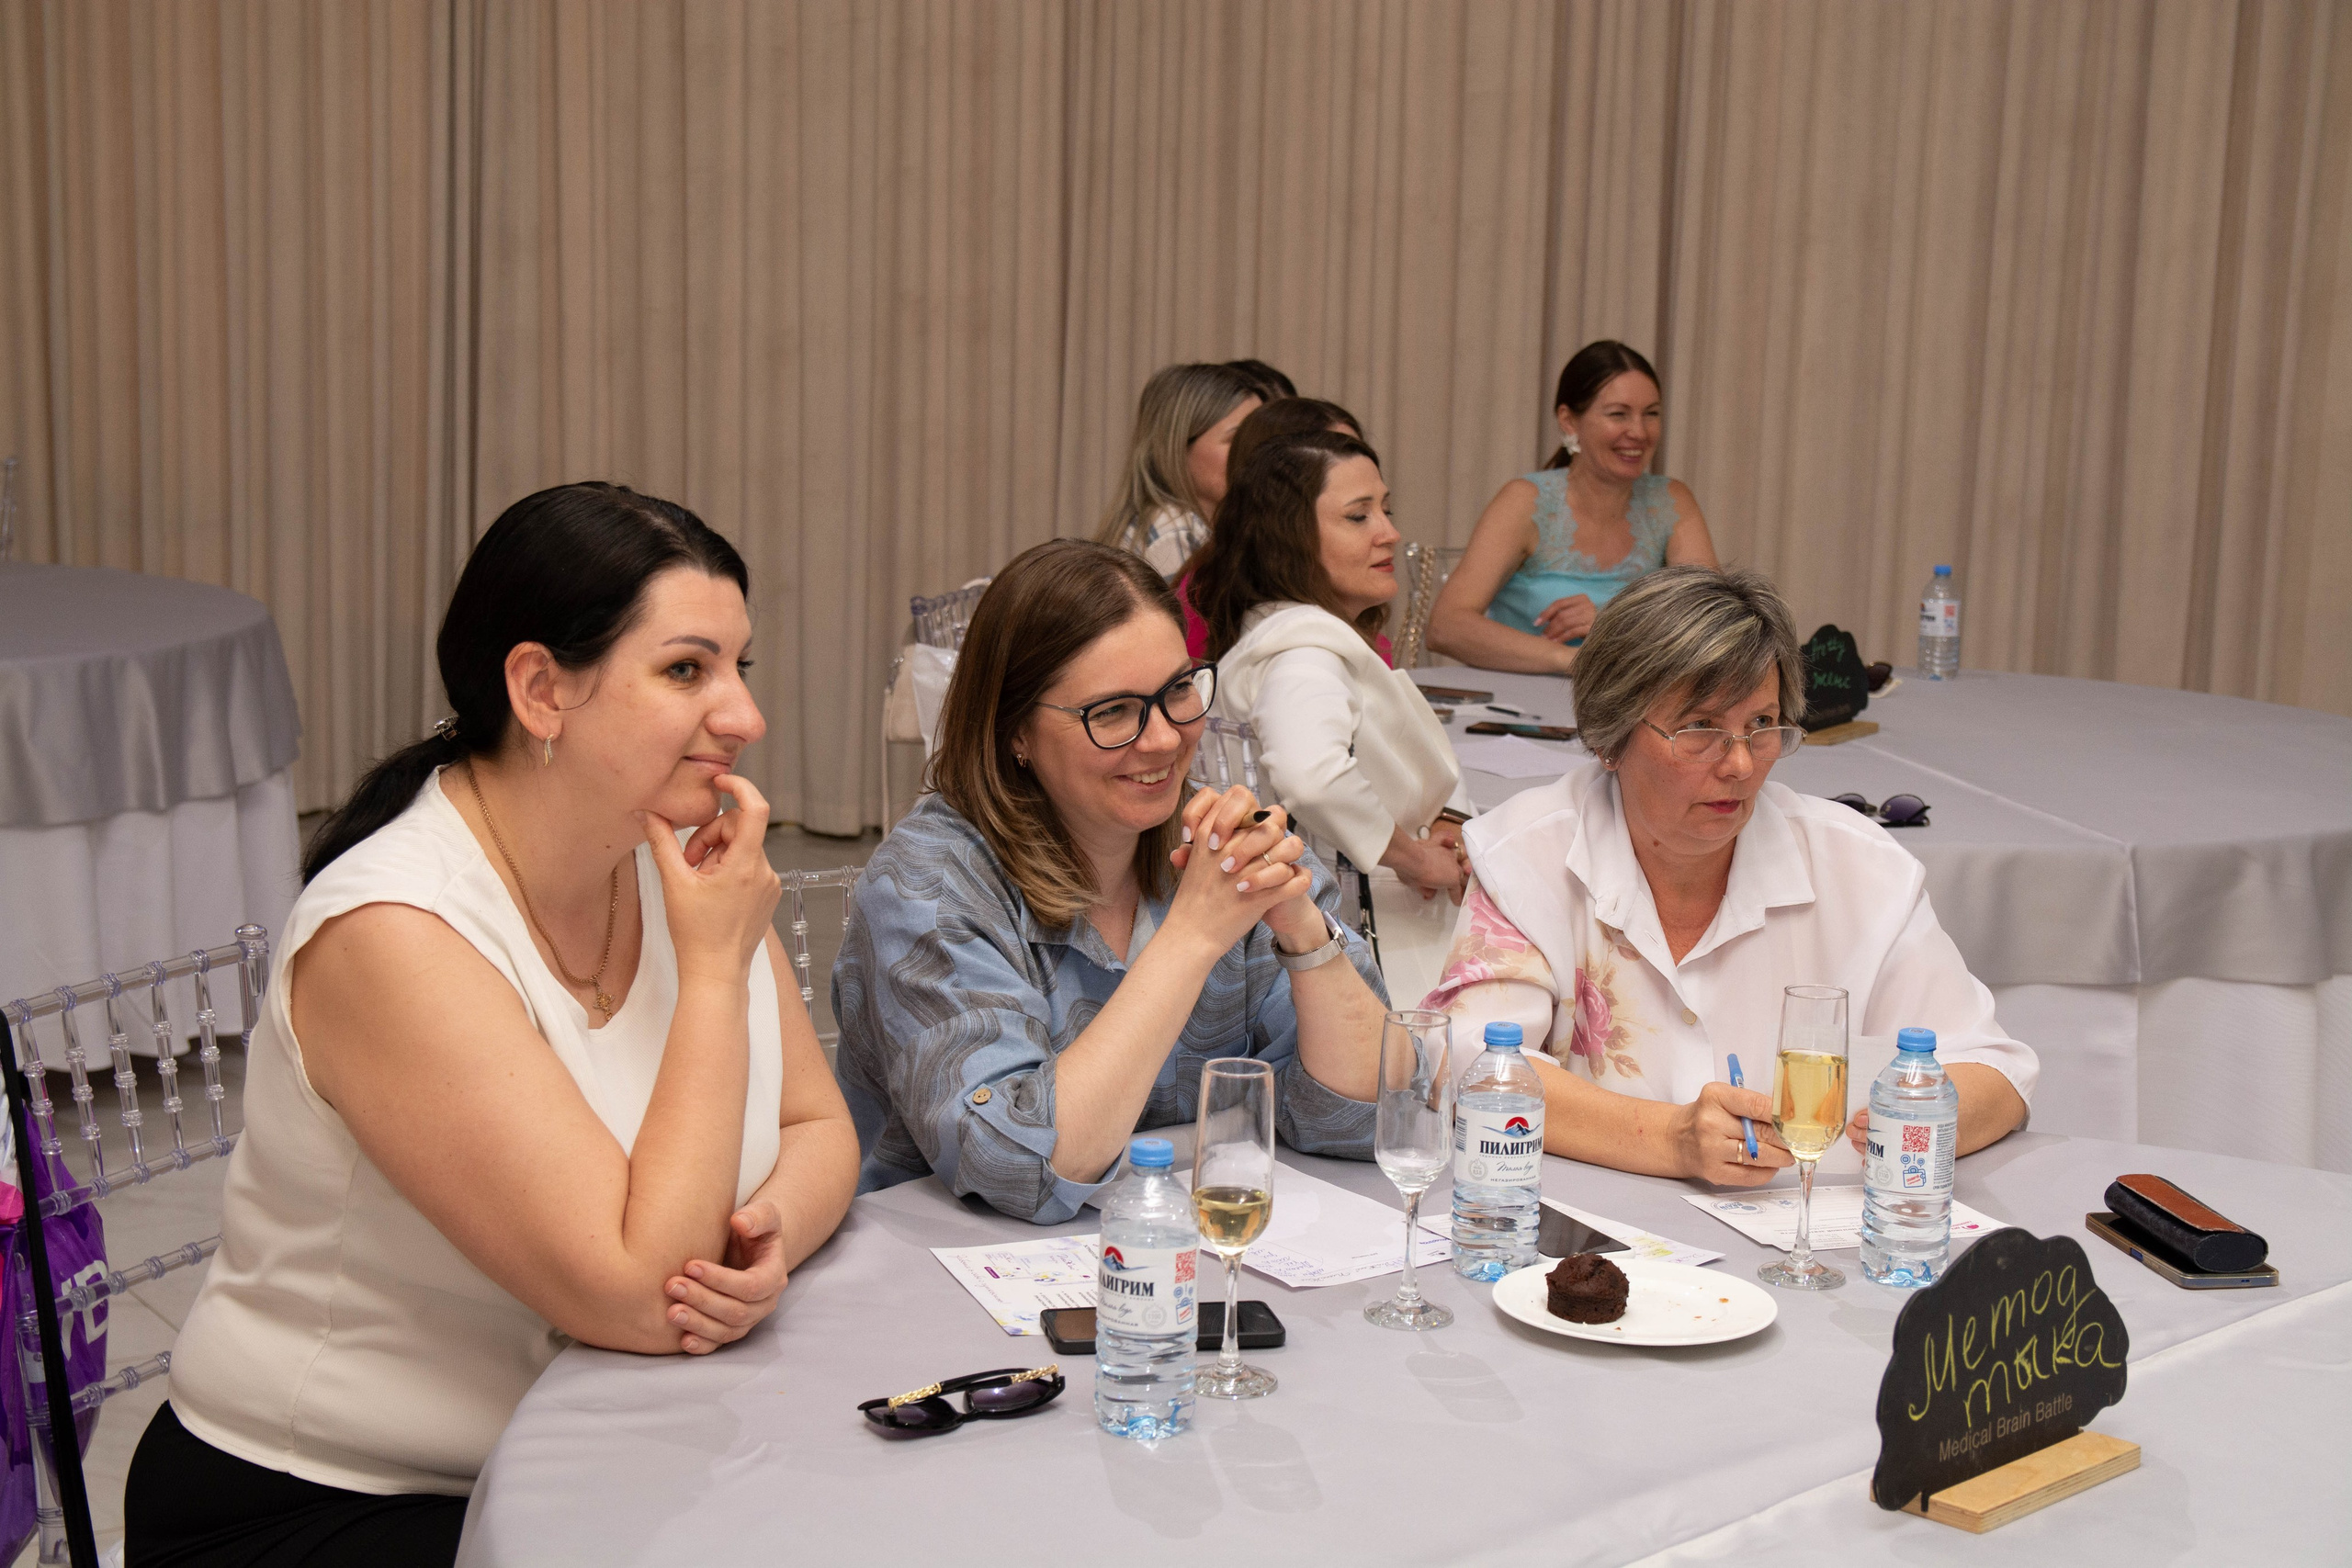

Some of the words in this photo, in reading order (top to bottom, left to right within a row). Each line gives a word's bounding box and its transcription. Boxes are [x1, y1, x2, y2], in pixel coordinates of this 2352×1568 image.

[1480, 1137, 1543, 1156] ПИЛИГРИМ
[1939, 1427, 1992, 1462] Medical
[1996, 1409, 2031, 1438] Brain
[2036, 1393, 2073, 1424] Battle
